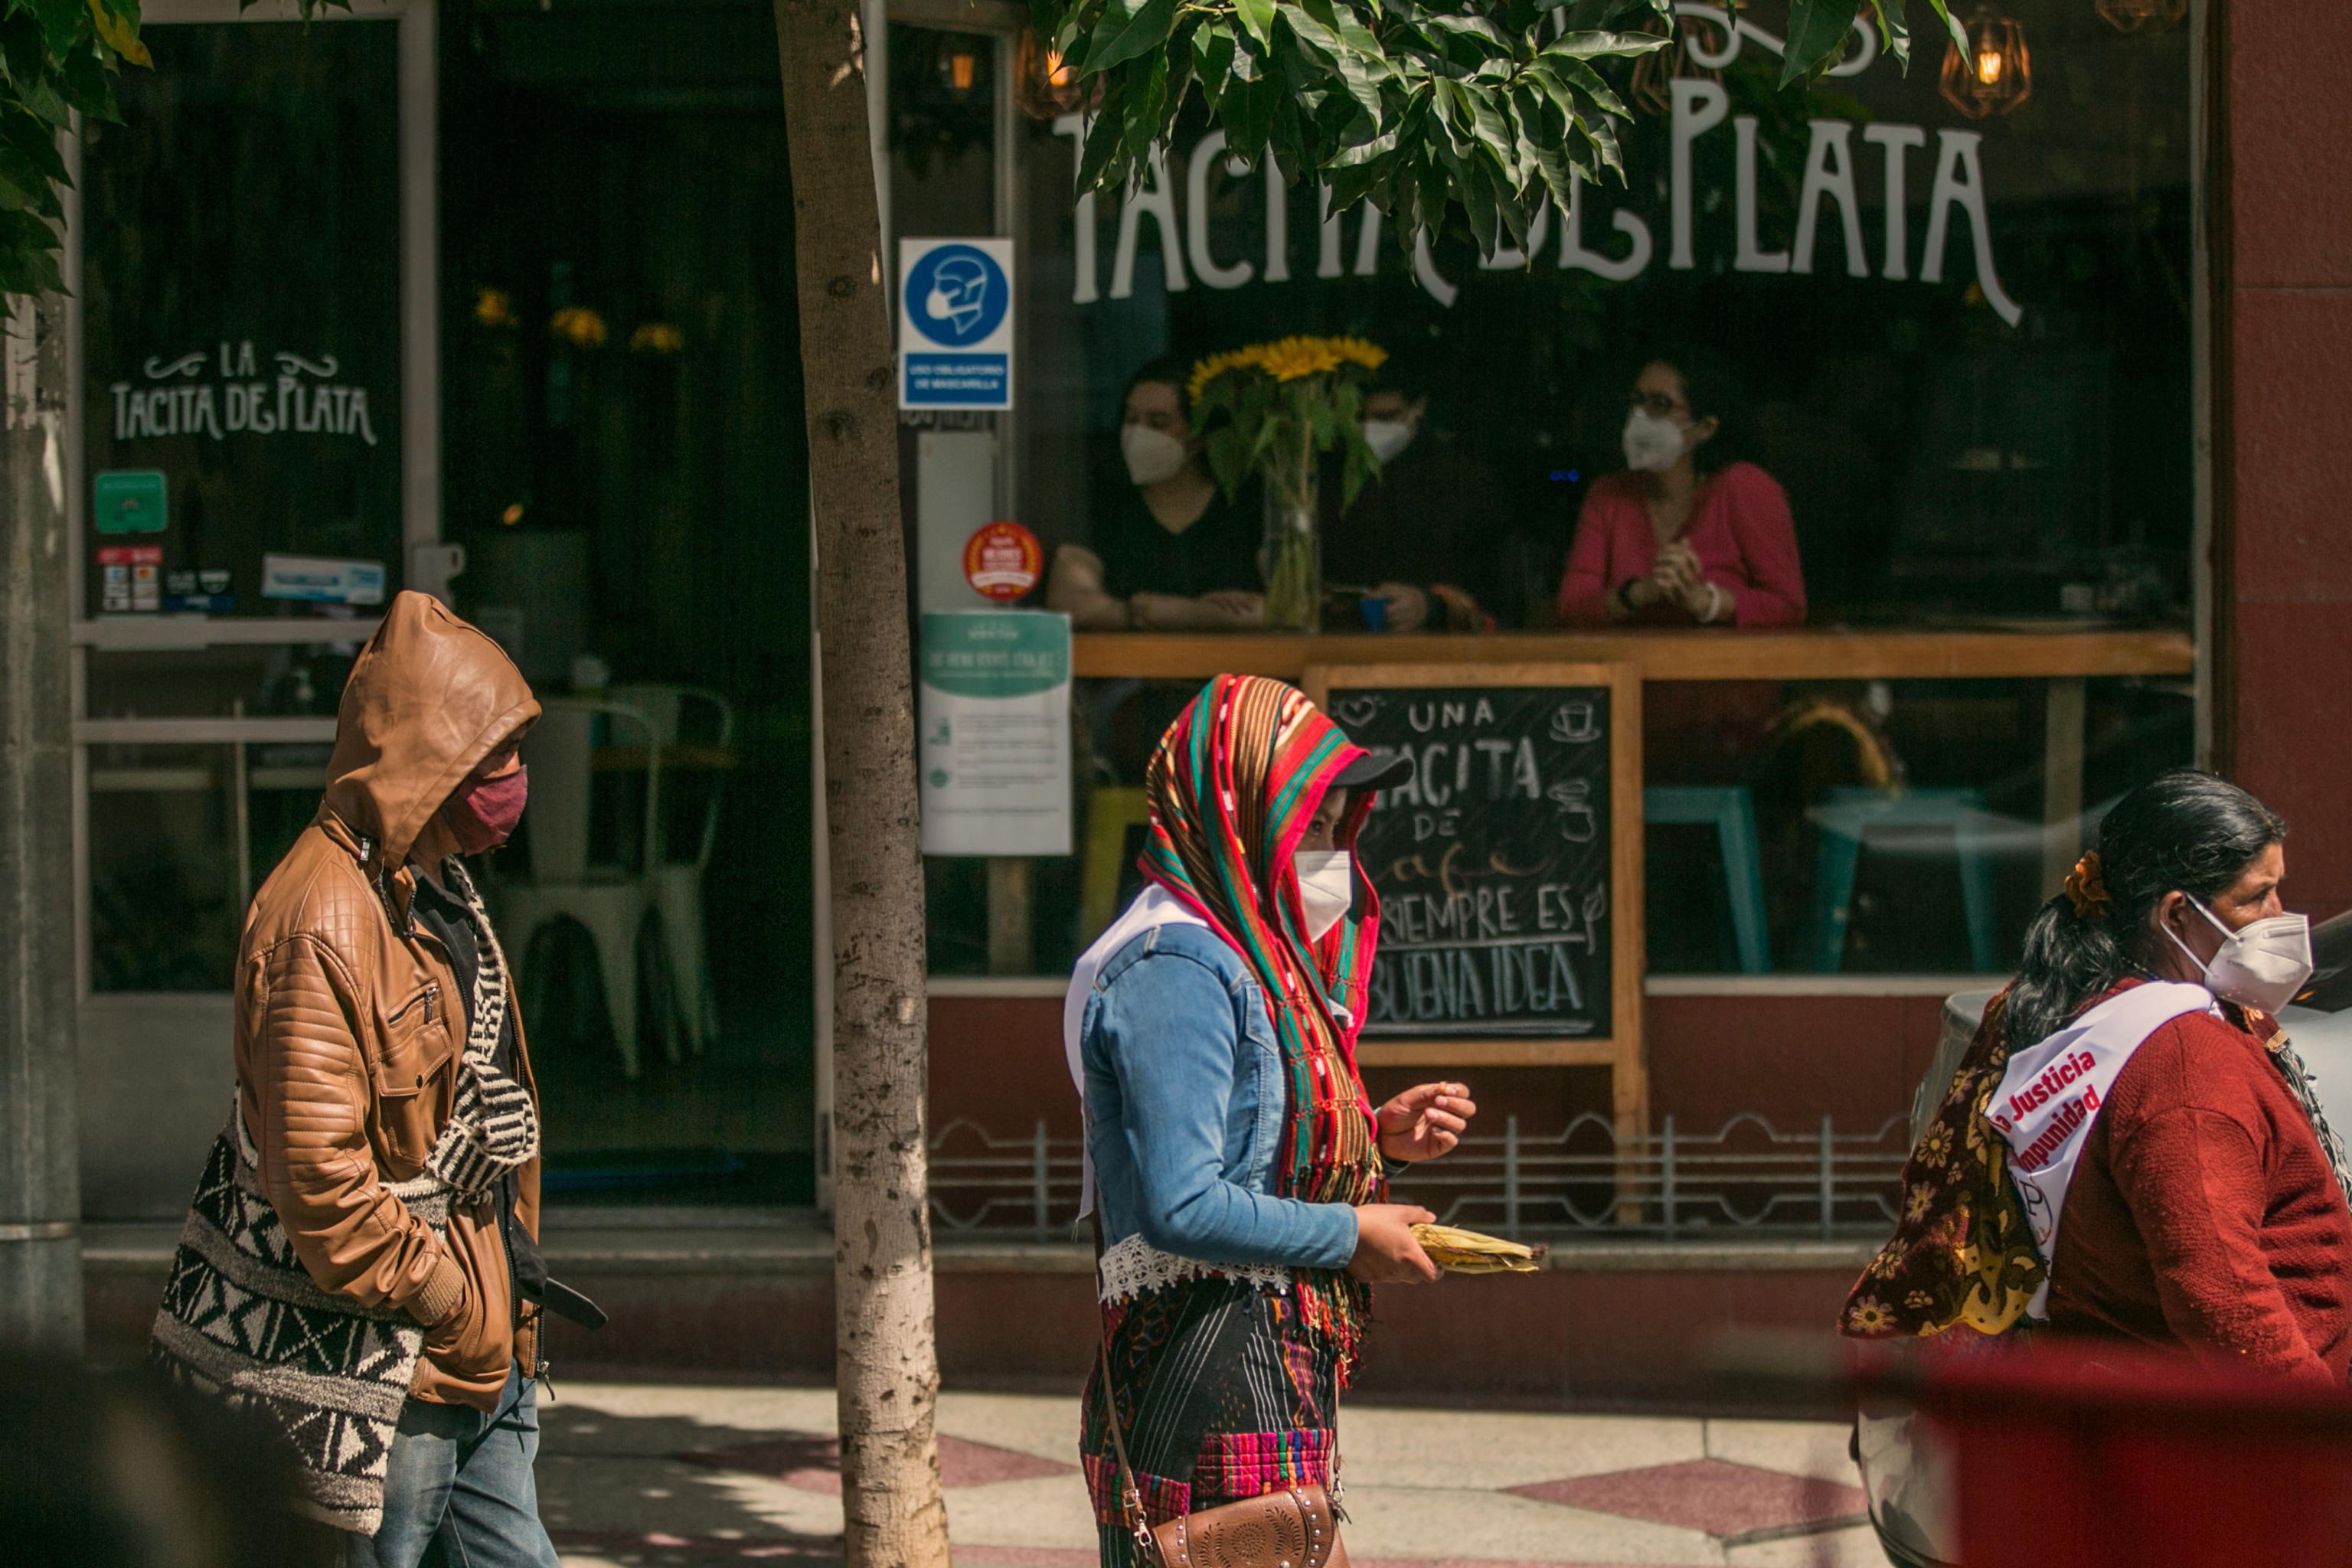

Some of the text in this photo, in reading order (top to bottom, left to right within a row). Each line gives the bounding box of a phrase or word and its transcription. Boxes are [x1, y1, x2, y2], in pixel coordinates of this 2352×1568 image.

[1669, 77, 2022, 328] PLATA
[220, 340, 255, 377] LA
[110, 374, 377, 446] TACITA DE PLATA
[1409, 697, 1494, 733] UNA
[1414, 808, 1461, 841] DE
[1380, 884, 1576, 944] SIEMPRE ES
[1369, 942, 1583, 1024] BUENA IDEA
[2009, 1050, 2096, 1122] Justicia
[2018, 1084, 2102, 1174] mpunidad
